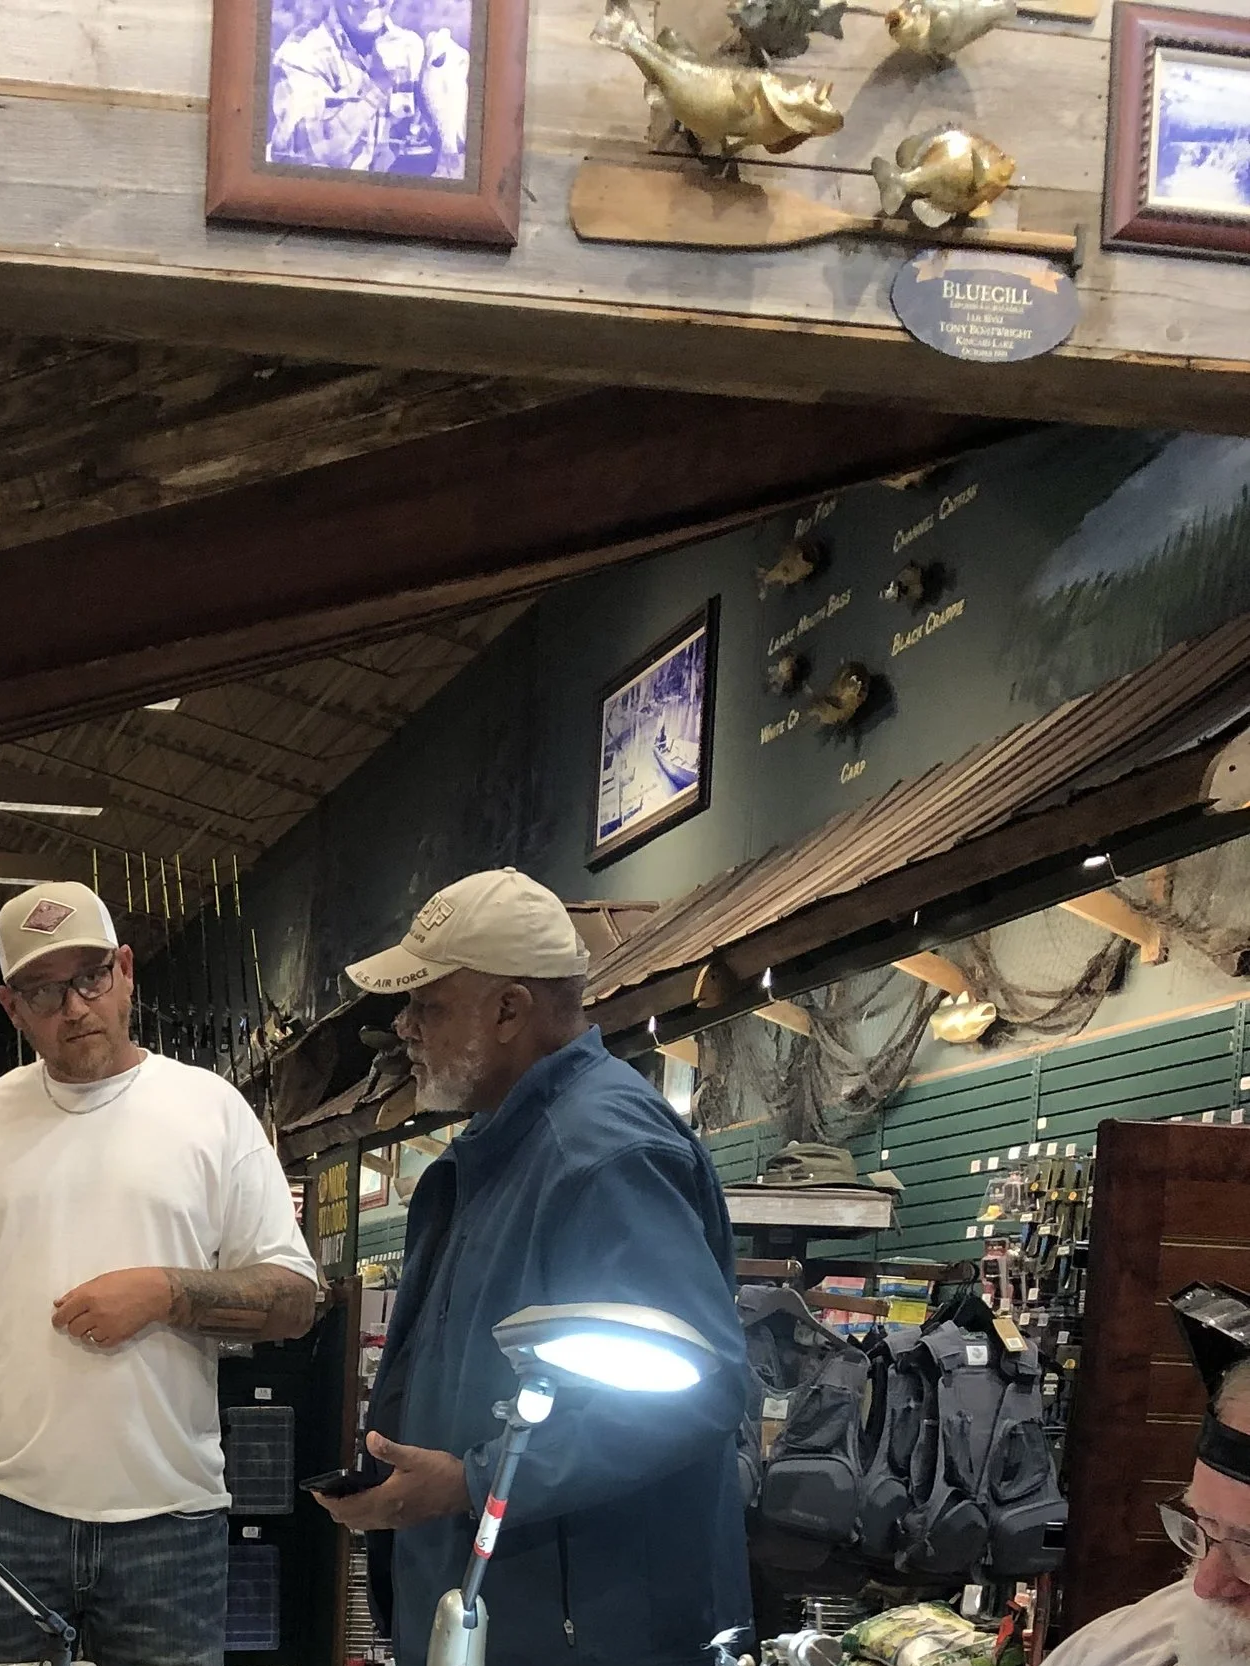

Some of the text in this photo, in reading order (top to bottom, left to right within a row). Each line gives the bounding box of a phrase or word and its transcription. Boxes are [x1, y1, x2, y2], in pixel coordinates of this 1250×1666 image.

[942, 279, 1033, 306] BLUEGILL
[891, 624, 923, 657] BLACK
[840, 759, 867, 784] CARP
[373, 978, 391, 988] AIR
[396, 967, 429, 987] FORCE
